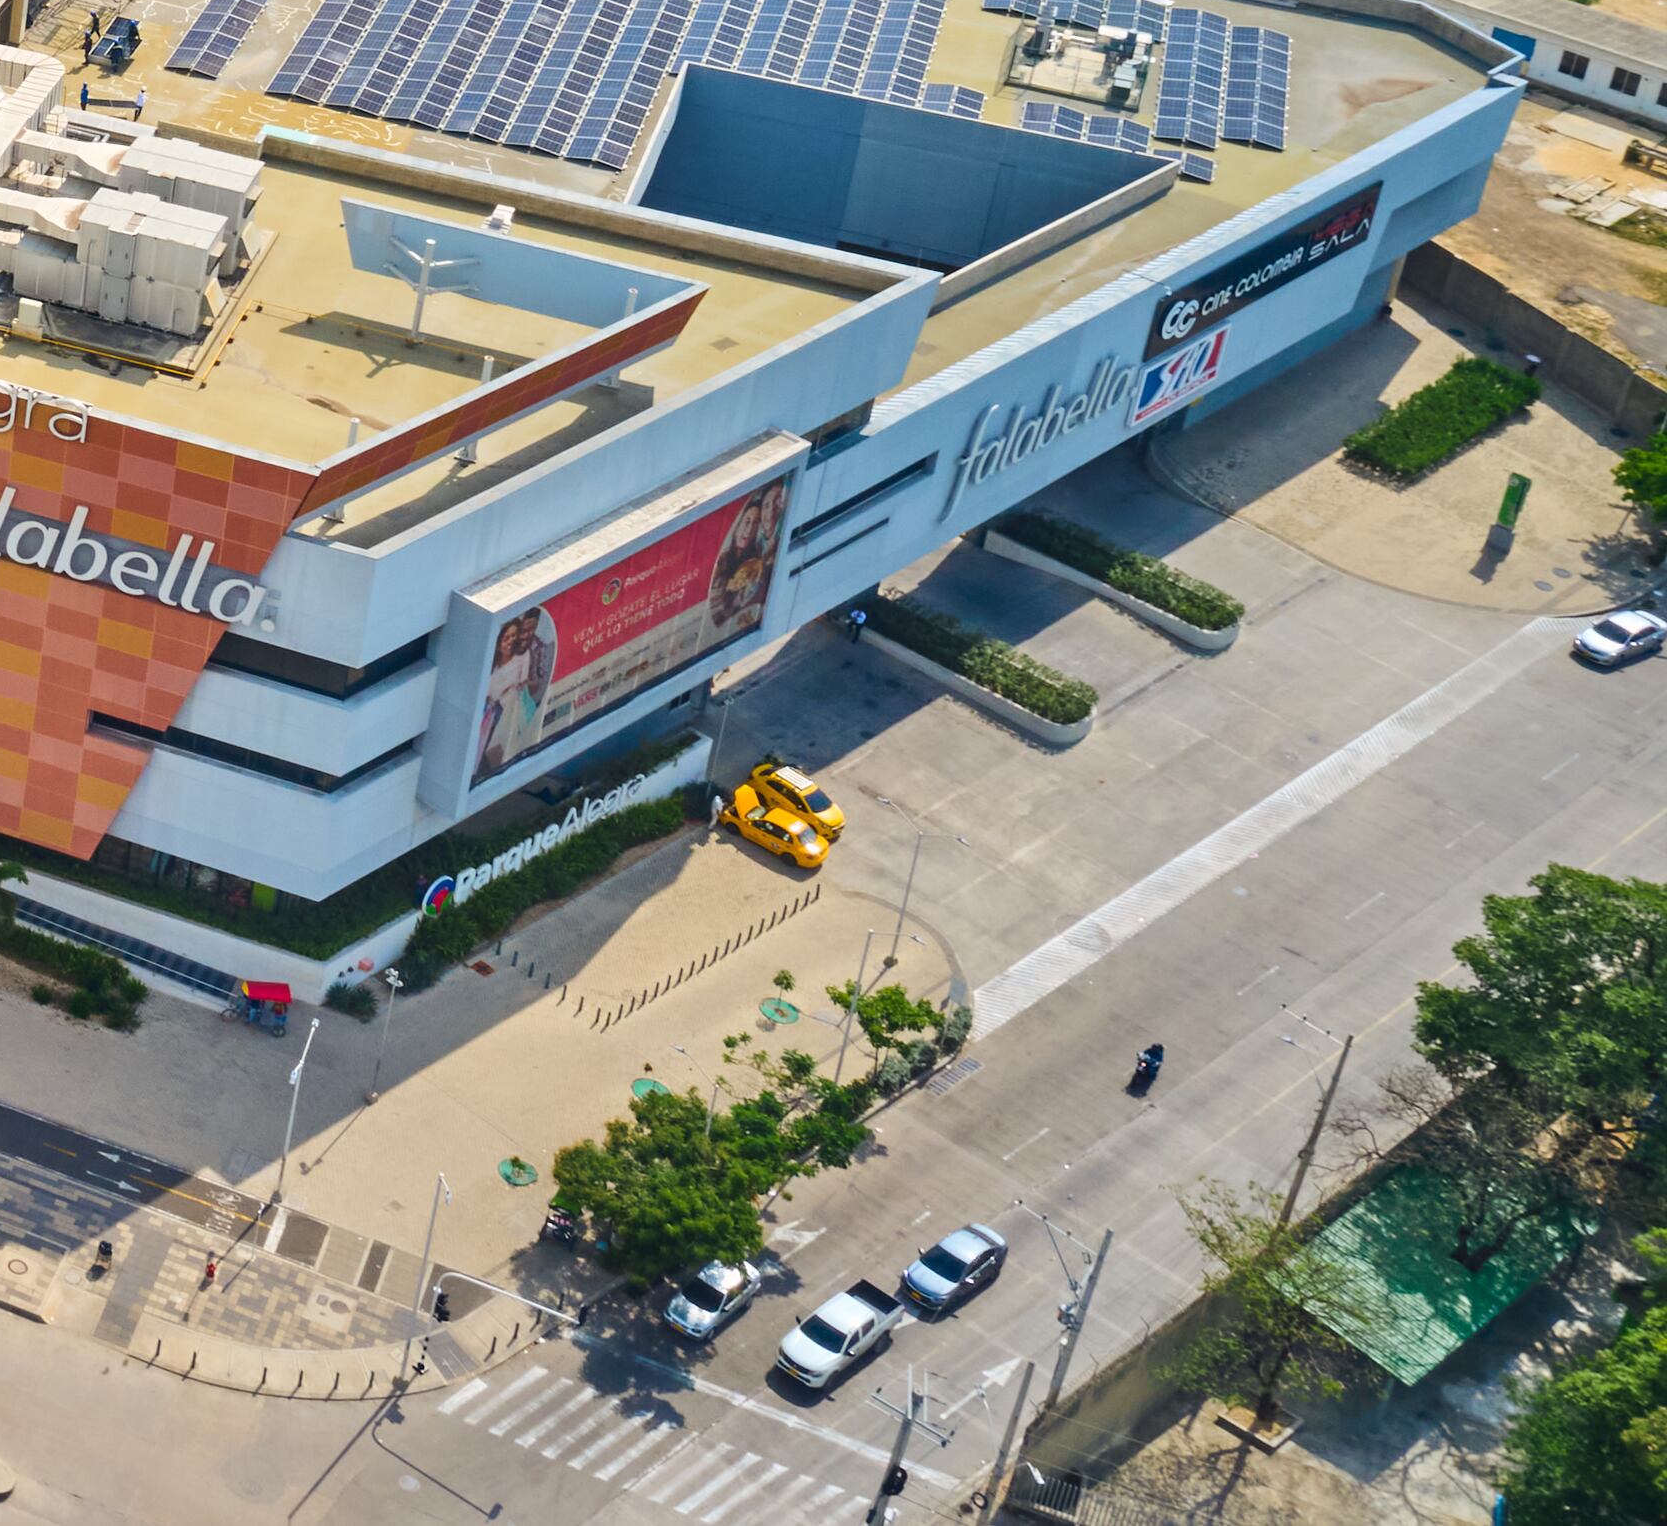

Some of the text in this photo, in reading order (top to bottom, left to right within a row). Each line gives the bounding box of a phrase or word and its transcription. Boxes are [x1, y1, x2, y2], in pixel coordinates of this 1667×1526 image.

[1202, 286, 1232, 317] CINE
[1234, 245, 1304, 298] COLOMBIA
[1308, 217, 1370, 262] SALA
[582, 588, 686, 654] QUE LO TIENE TODO
